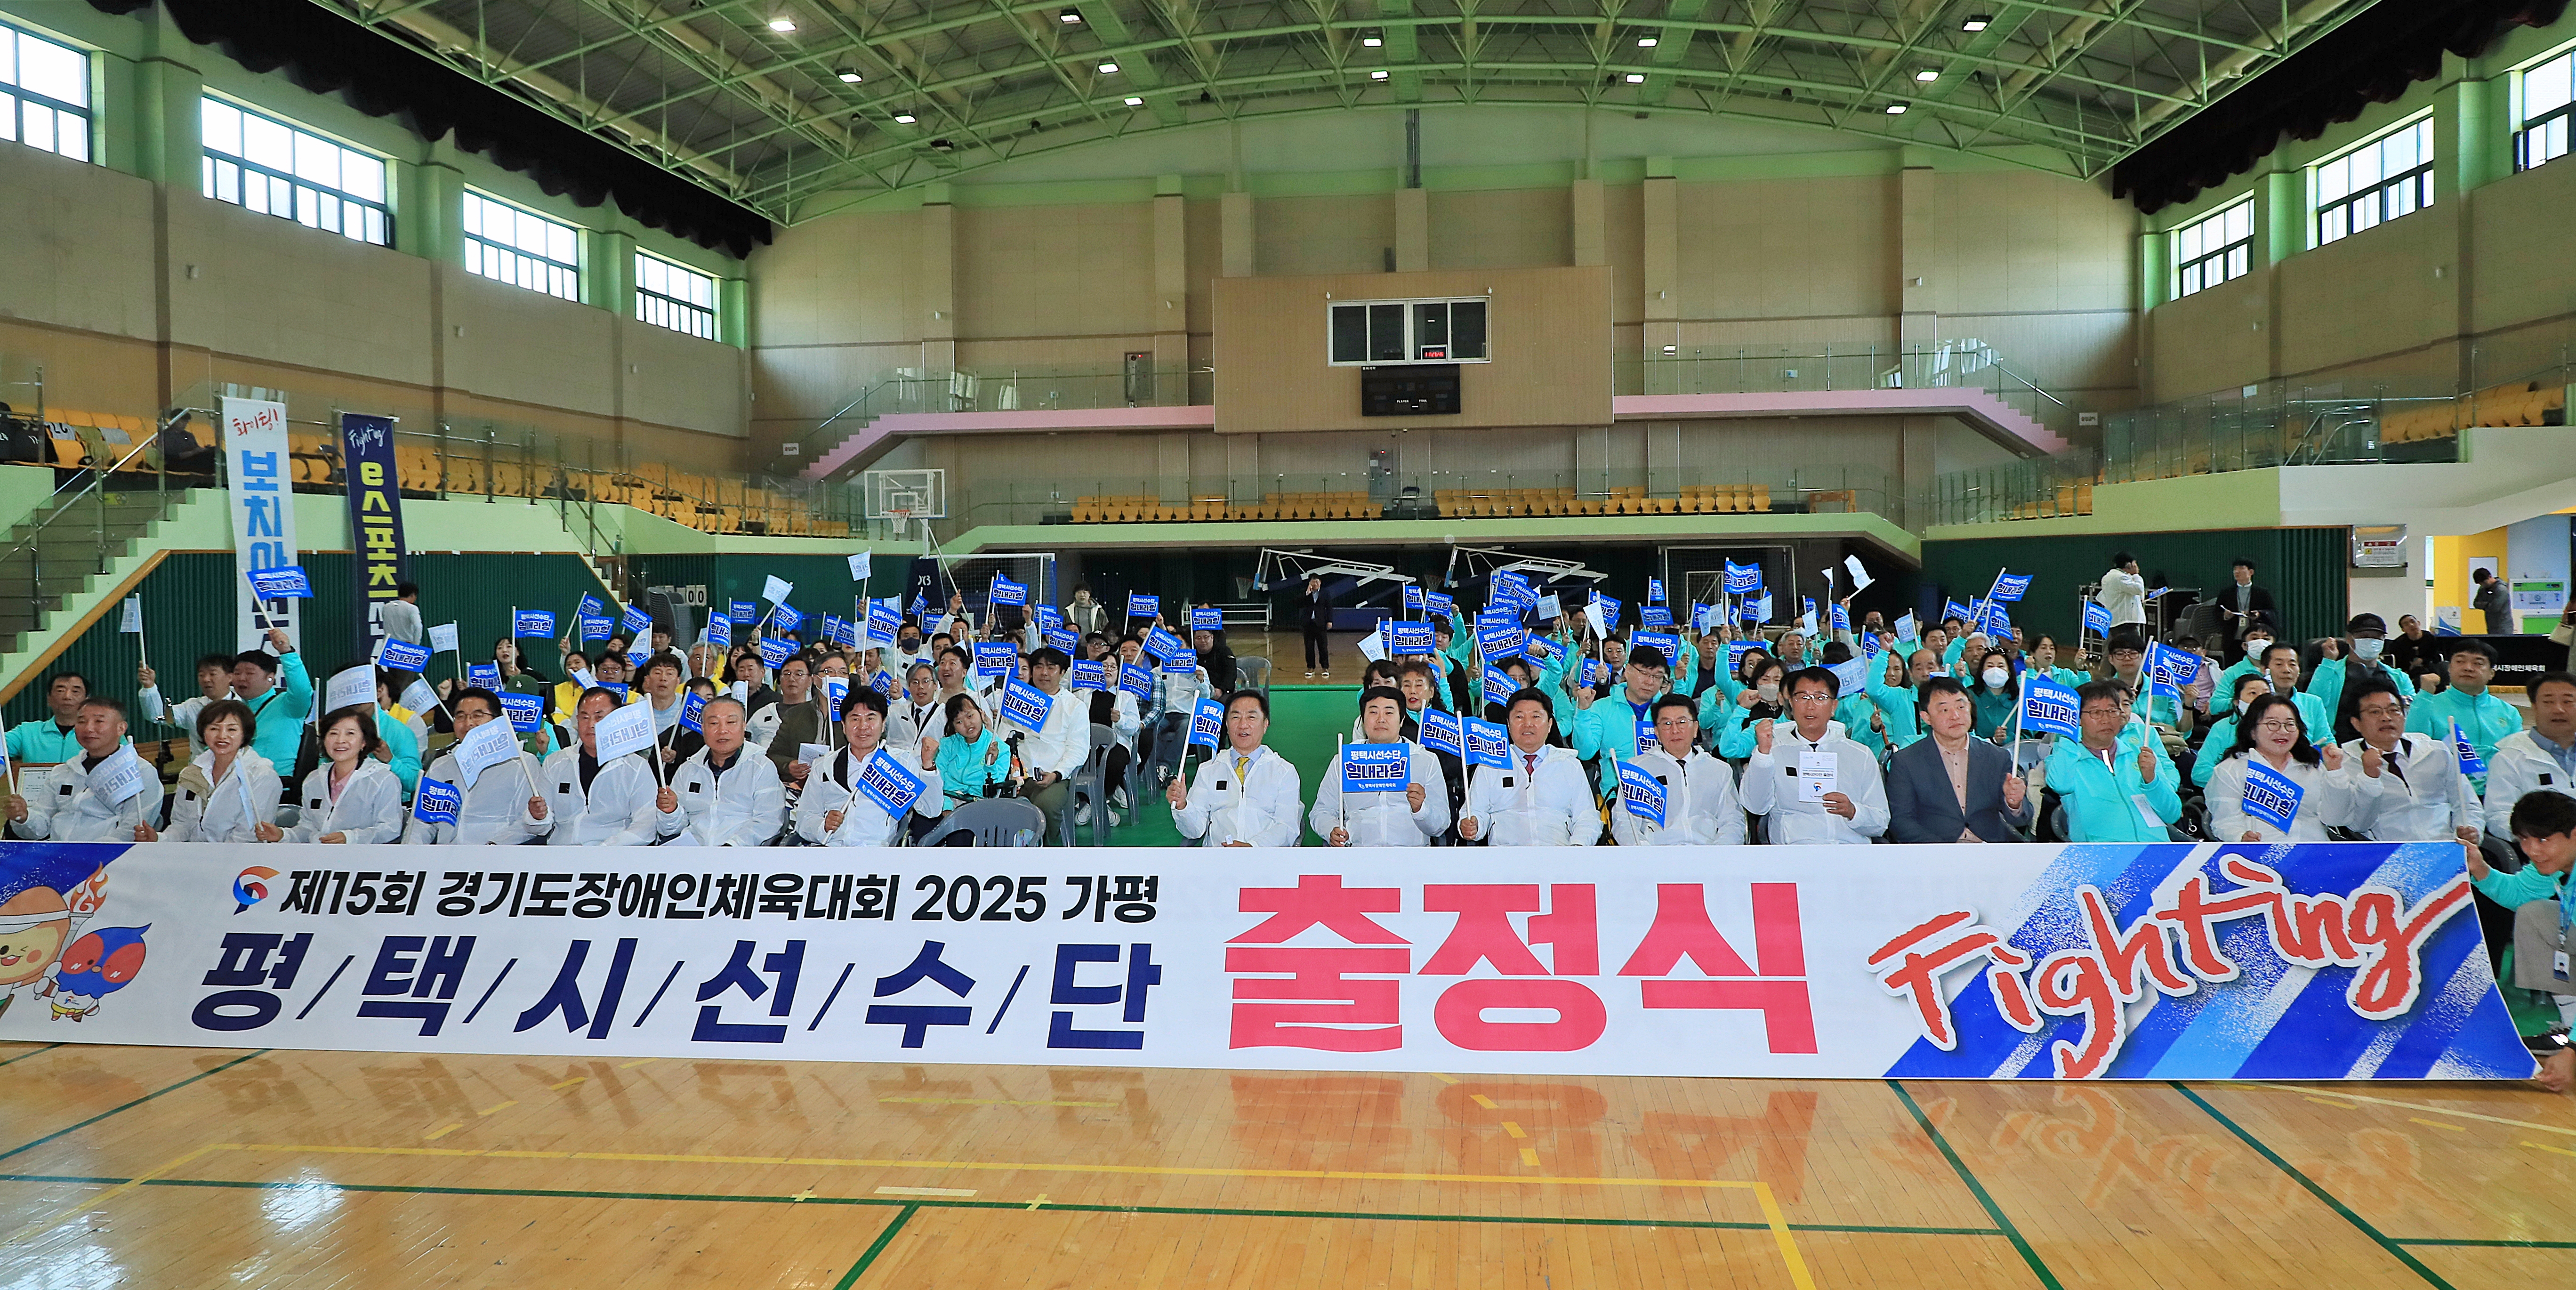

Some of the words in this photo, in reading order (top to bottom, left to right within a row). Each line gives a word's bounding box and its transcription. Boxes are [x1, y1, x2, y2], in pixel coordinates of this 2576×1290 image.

[232, 408, 279, 436] 화이팅!
[349, 423, 387, 456] Fighting
[360, 461, 398, 598] e스포츠
[993, 588, 1026, 601] 힘내라힘
[1509, 587, 1536, 606] 힘내라힘
[1130, 602, 1157, 613] 힘내라힘
[516, 619, 553, 632] 힘내라힘
[1192, 614, 1221, 626] 힘내라힘
[1393, 631, 1434, 647] 힘내라힘
[1397, 627, 1431, 635] 평택시선수단
[1483, 626, 1517, 641] 평택시선수단
[1637, 635, 1672, 645] 평택시선수단
[980, 647, 1012, 655] 평택시선수단
[1049, 635, 1077, 651] 힘내라힘
[1481, 629, 1523, 654] 힘내라힘
[976, 653, 1016, 669] 힘내라힘
[1123, 673, 1151, 693] 힘내라힘
[1487, 669, 1516, 691] 평택시선수단
[500, 696, 536, 707] 택시선수단
[1008, 682, 1046, 707] 평택시선수단
[1202, 705, 1224, 721] 평택시
[1429, 714, 1459, 731] 평택시선수
[1350, 750, 1401, 760] 평택시선수단
[1465, 733, 1507, 758] 힘내라힘
[875, 756, 916, 792] 평택시선수단
[1344, 757, 1408, 780] 힘내라힘
[861, 763, 917, 809] 힘내라힘
[1621, 769, 1662, 797] 평택시선수단
[2246, 767, 2295, 799] 평택시선수단
[421, 792, 459, 816] 힘내라
[279, 869, 427, 917] 제15회
[435, 871, 900, 921] 경기도장애인체육대회
[911, 874, 1047, 923] 2025
[1062, 875, 1159, 924] 가평
[1223, 874, 1819, 1055] 출정식
[1867, 859, 2471, 1080] Fighting
